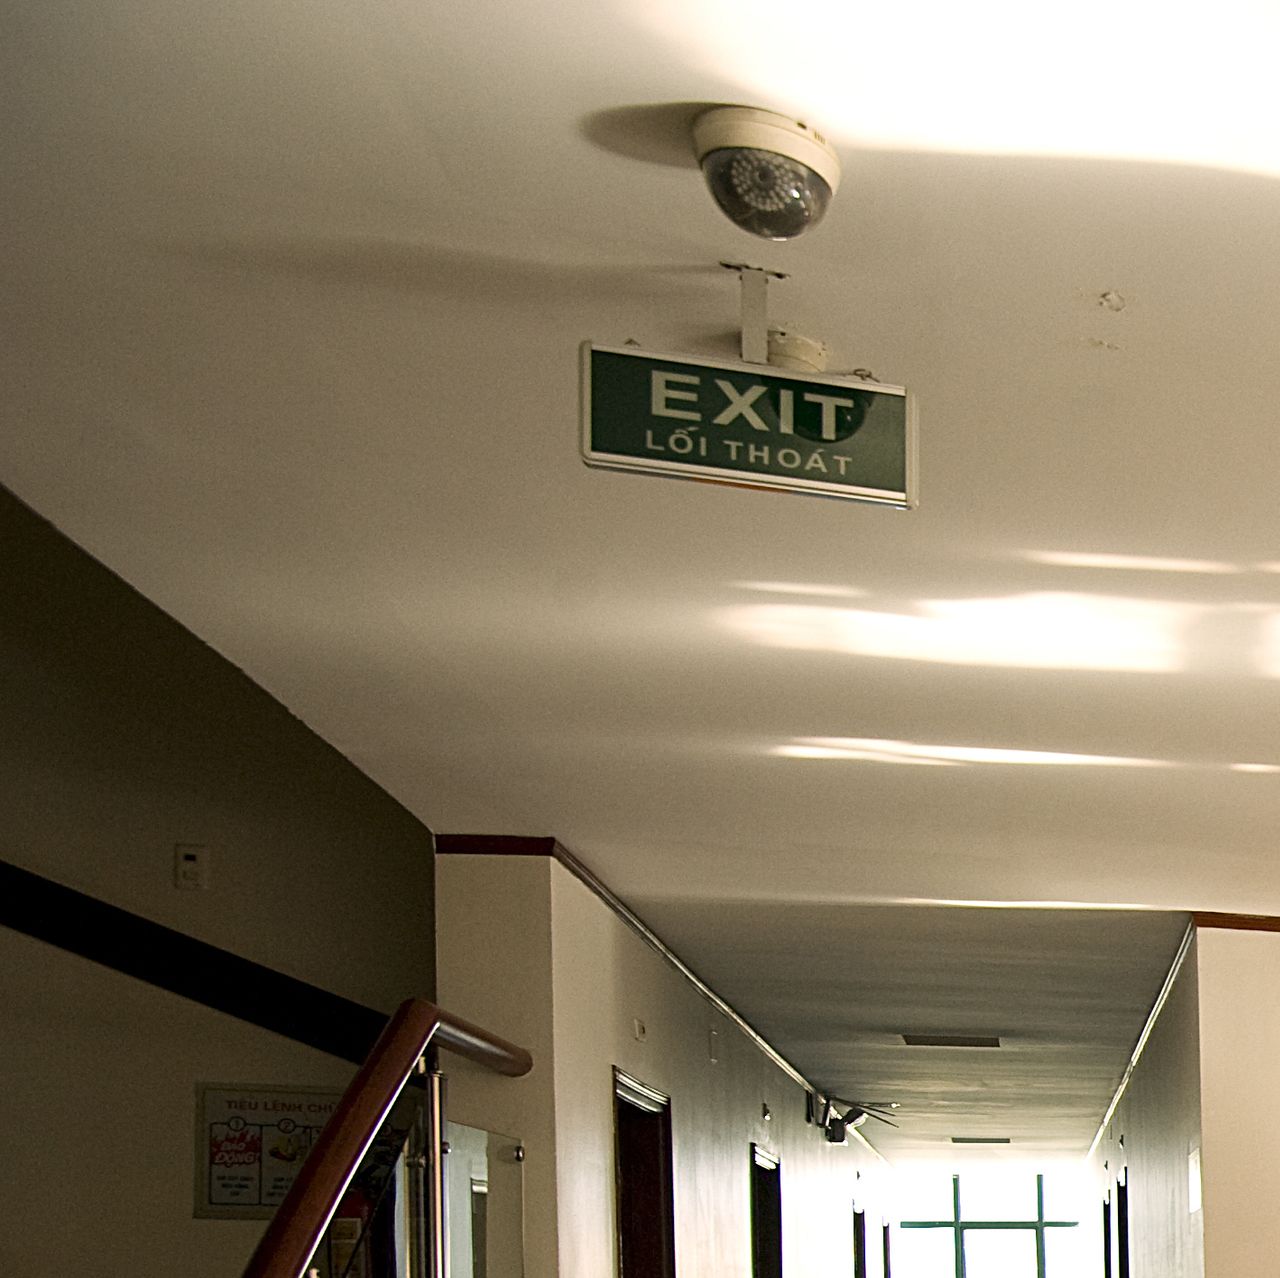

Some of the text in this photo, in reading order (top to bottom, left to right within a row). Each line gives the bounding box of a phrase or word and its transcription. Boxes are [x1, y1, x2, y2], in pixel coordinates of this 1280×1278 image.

[652, 370, 854, 440] EXIT
[646, 426, 852, 475] LỐI THOÁT
